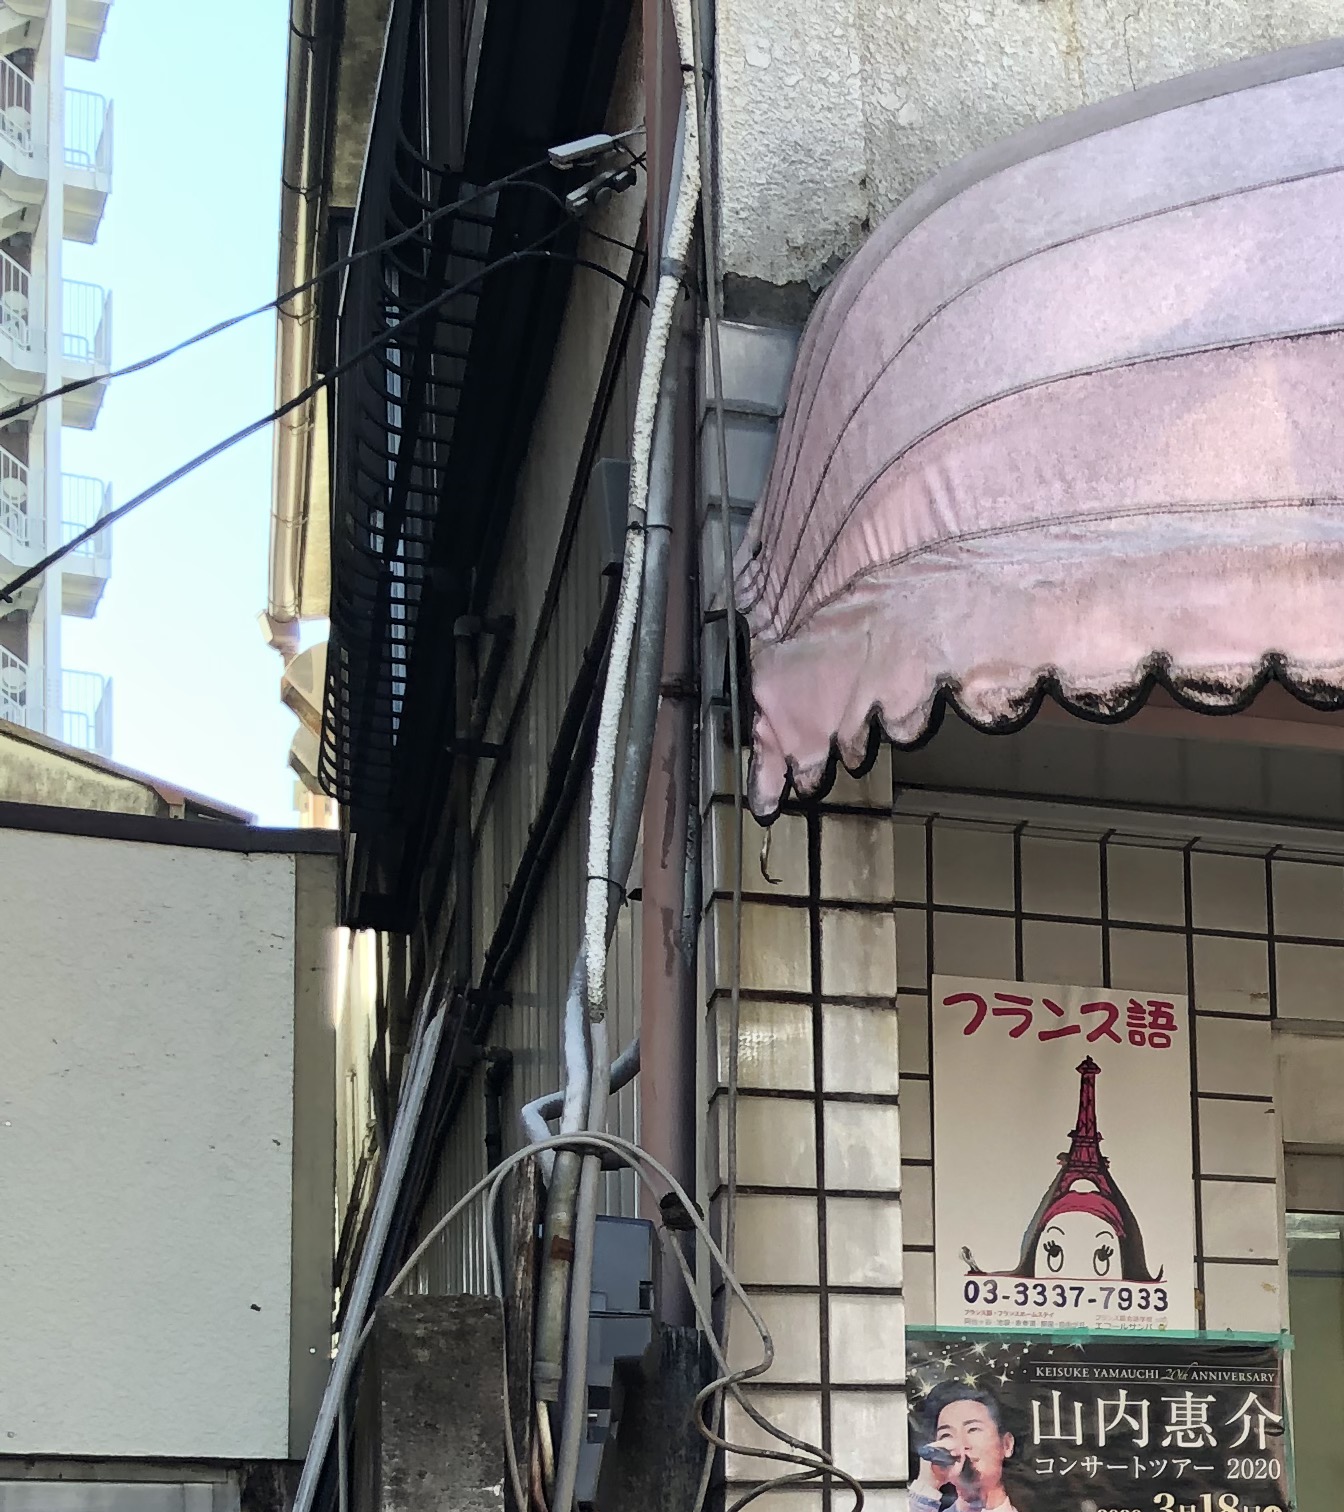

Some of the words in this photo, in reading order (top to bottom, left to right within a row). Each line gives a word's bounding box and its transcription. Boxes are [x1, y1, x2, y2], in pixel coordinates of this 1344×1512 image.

[943, 992, 1178, 1048] フランス語
[963, 1279, 1169, 1312] 03-3337-7933
[1036, 1367, 1090, 1379] KEISUKE
[1093, 1368, 1160, 1381] YAMAUCHI
[1191, 1370, 1275, 1383] ANNIVERSARY
[1031, 1389, 1283, 1450] 山内惠介
[1035, 1456, 1215, 1478] コンサートツアー
[1227, 1458, 1281, 1480] 2020
